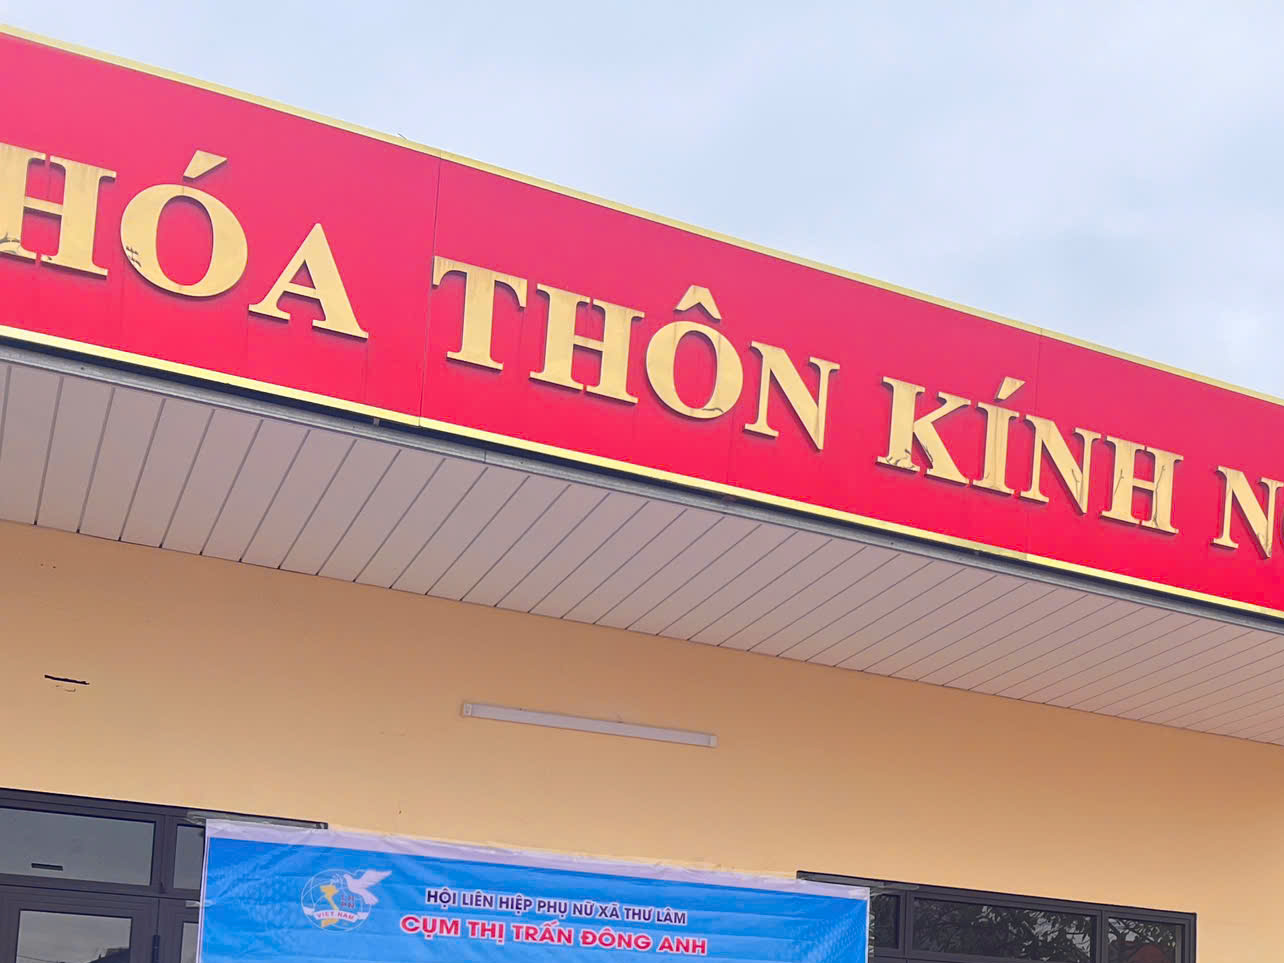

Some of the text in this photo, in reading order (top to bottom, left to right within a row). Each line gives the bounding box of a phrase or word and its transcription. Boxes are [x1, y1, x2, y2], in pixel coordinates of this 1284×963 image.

[0, 142, 369, 340] HÓA
[432, 256, 840, 451] THÔN
[876, 376, 1184, 535] KÍNH
[427, 888, 686, 924] HỘI LIÊN HIỆP PHỤ NỮ XÃ THƯ LÂM
[401, 916, 706, 954] CỤM THỊ TRẤN ĐÔNG ANH
